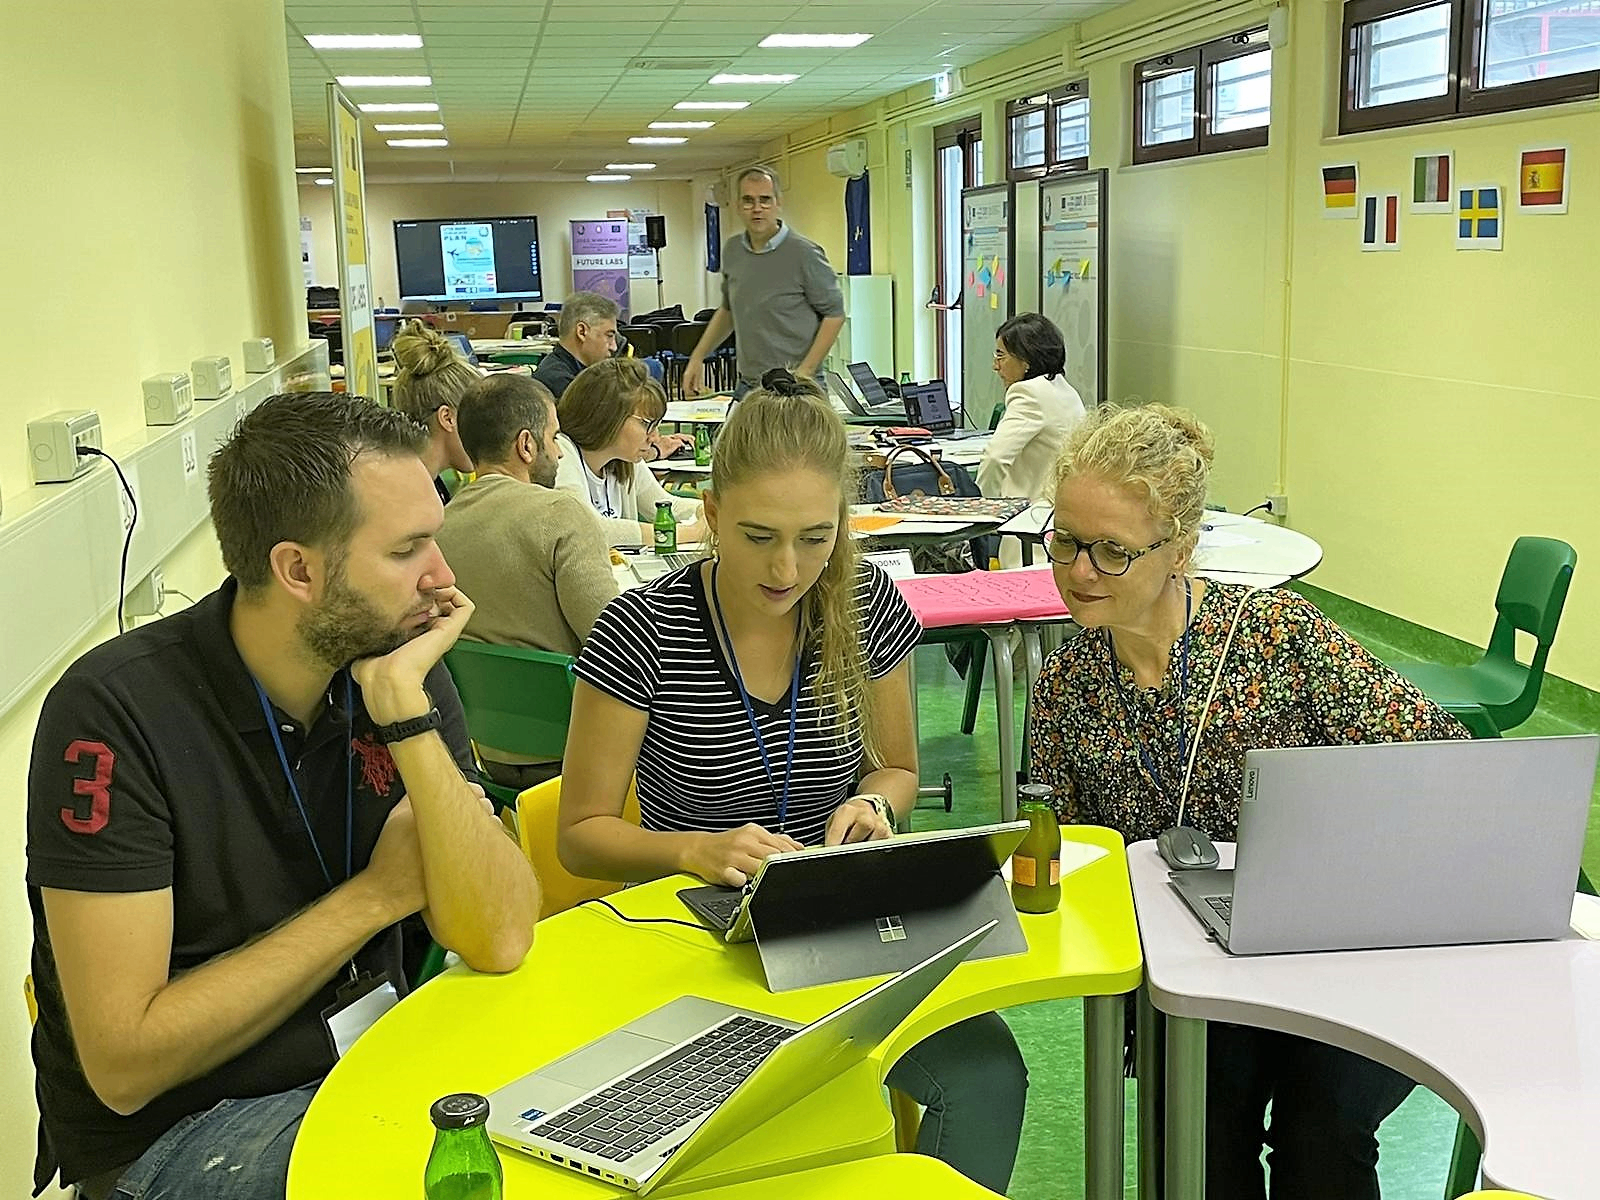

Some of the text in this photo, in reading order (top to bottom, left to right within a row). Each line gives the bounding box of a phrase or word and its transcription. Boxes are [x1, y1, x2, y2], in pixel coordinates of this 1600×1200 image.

[576, 257, 624, 266] FUTURE LABS
[60, 738, 116, 834] 3
[1245, 770, 1256, 799] Lenovo
